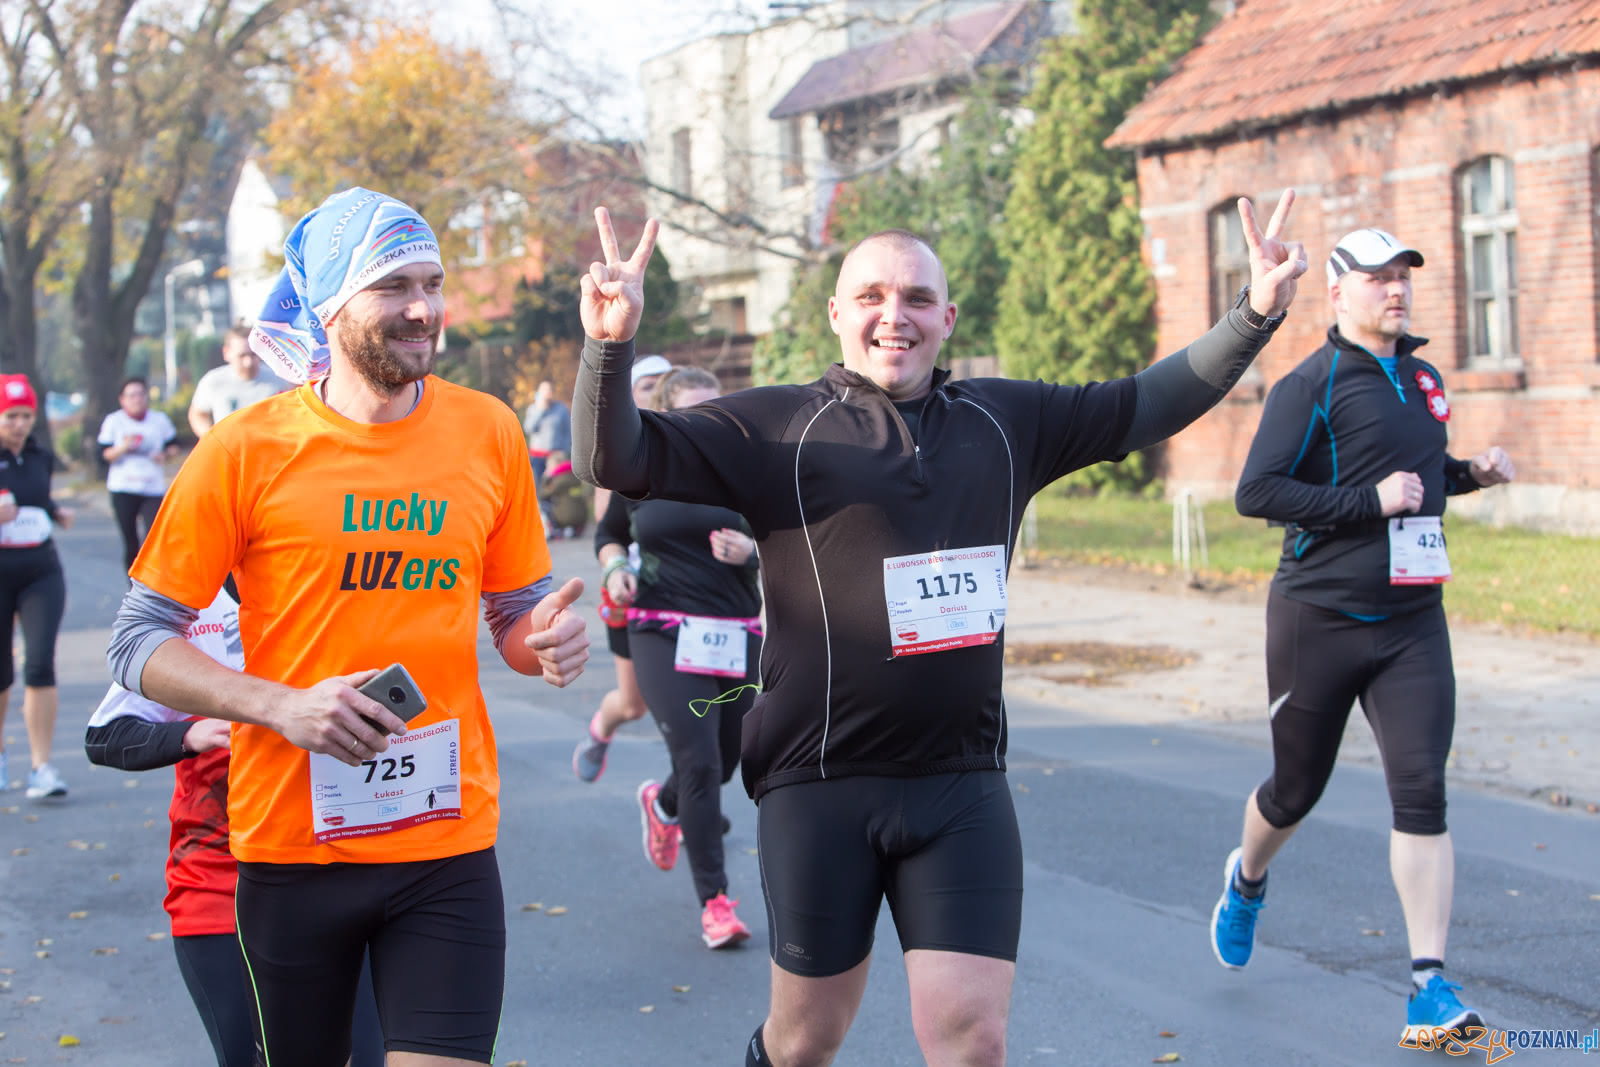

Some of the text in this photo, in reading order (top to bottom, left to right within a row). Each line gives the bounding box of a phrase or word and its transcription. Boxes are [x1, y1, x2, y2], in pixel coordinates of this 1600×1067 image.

[342, 492, 448, 536] Lucky
[340, 551, 460, 591] LUZers
[916, 572, 978, 600] 1175
[940, 604, 968, 614] Dariusz
[192, 623, 225, 637] LOTOS
[703, 632, 728, 647] 637
[390, 725, 452, 745] NIEPODLEGŁOŚCI
[361, 754, 416, 784] 725
[449, 749, 457, 776] STREFA
[374, 789, 404, 799] Łukasz
